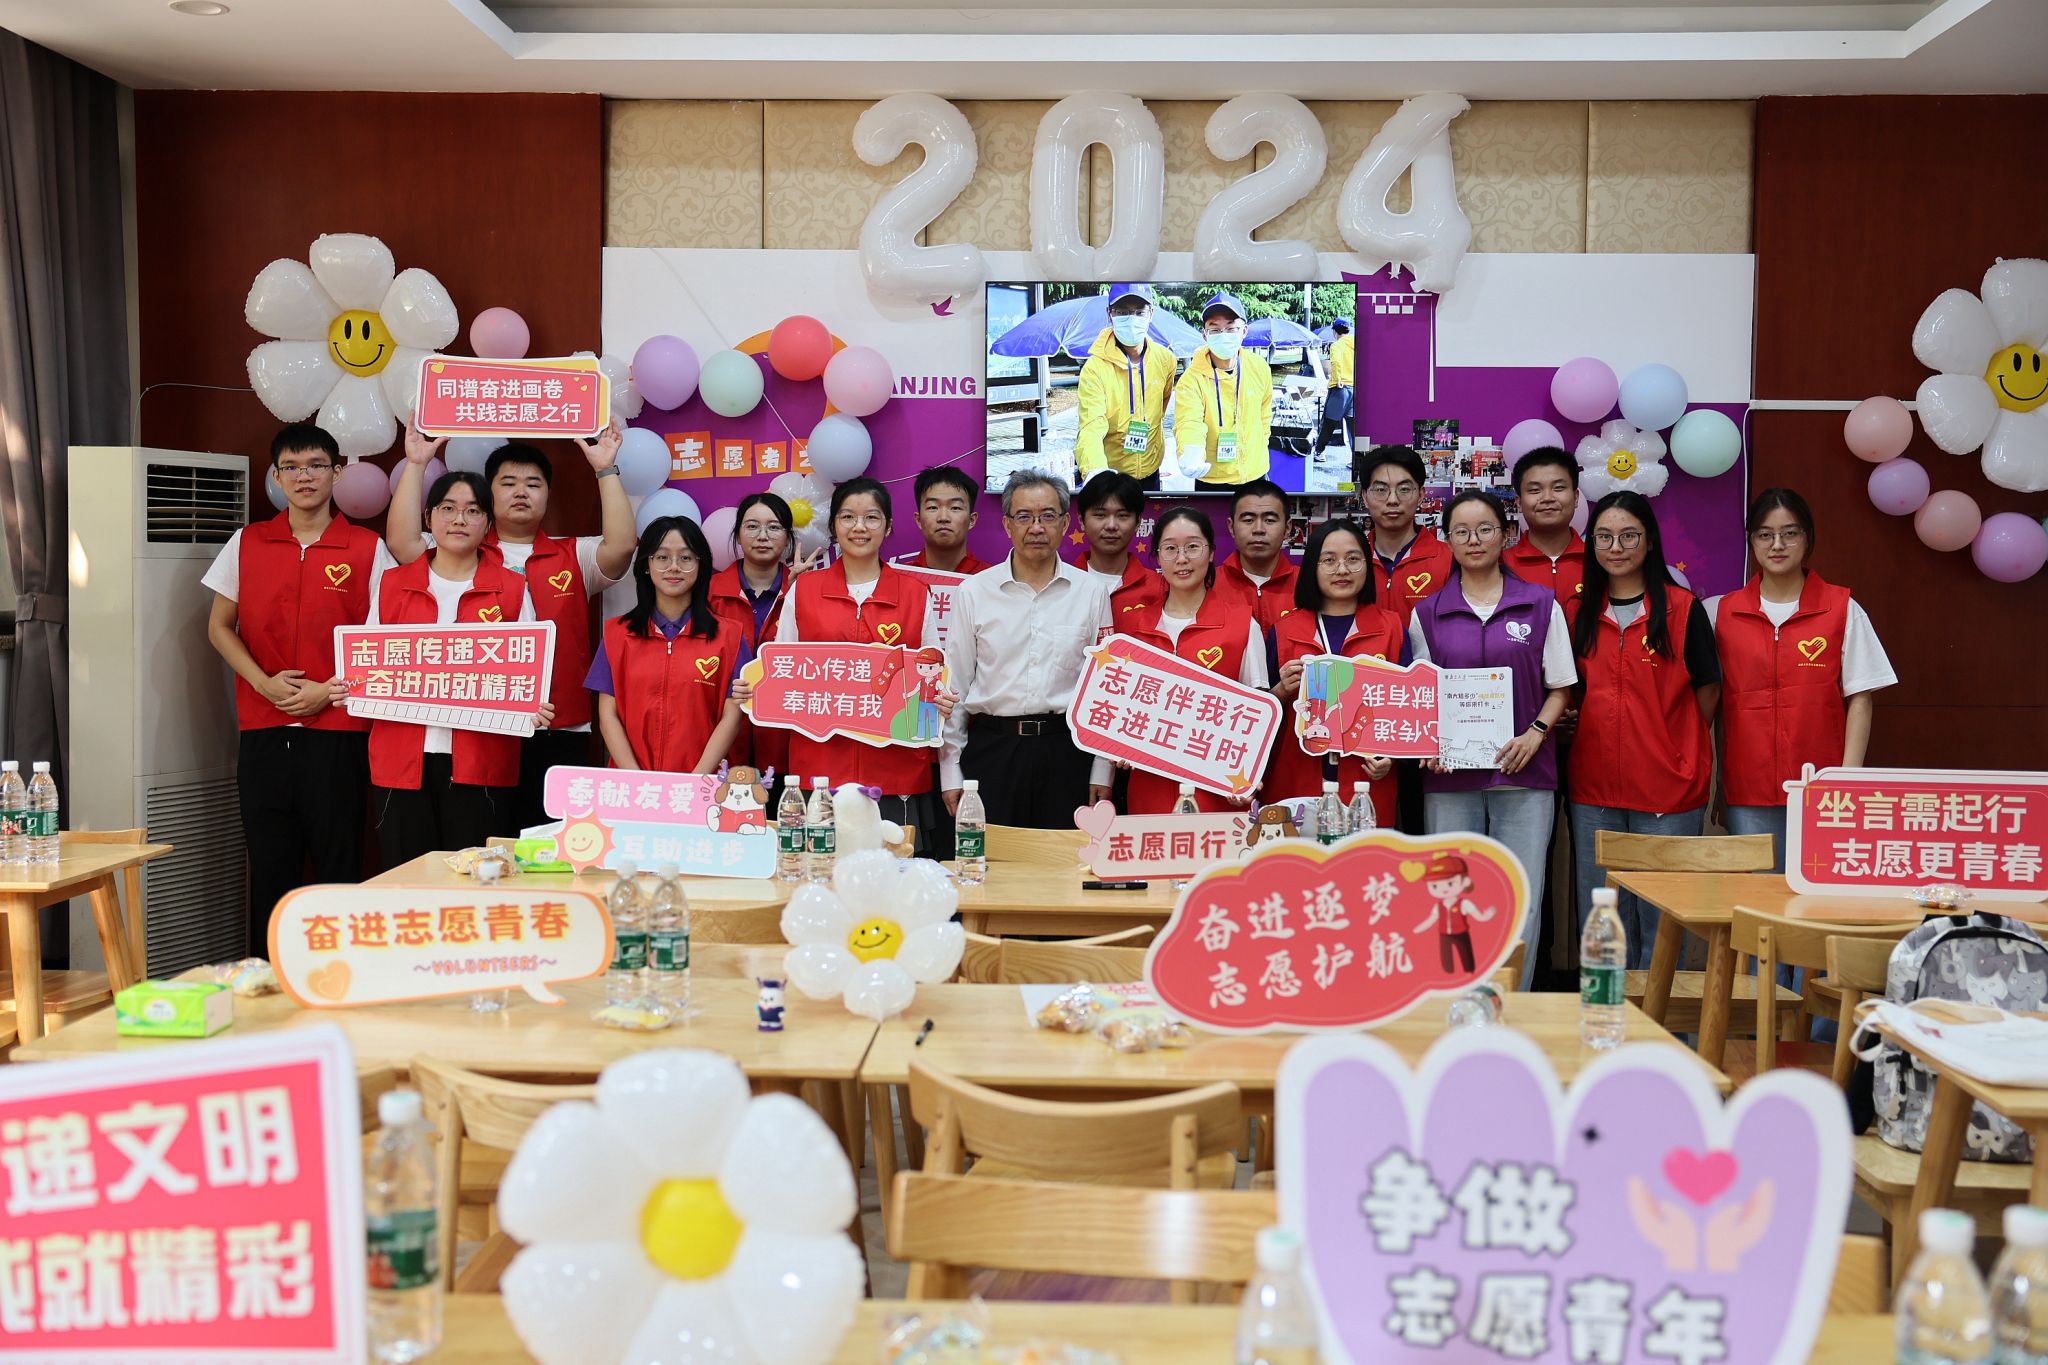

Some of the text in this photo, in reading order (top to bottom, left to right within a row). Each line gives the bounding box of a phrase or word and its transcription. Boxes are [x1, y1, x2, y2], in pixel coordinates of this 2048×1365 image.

[853, 92, 1473, 301] 2024
[436, 378, 563, 399] 同谱奋进画卷
[455, 402, 582, 423] 共践志愿之行
[350, 636, 536, 667] 志愿传递文明
[770, 655, 872, 683] 爱心传递
[364, 669, 536, 702] 奋进成就精彩
[782, 689, 883, 718] 奉献有我
[1098, 665, 1262, 735] 志愿伴我行
[1087, 699, 1248, 769] 奋进正当时
[567, 776, 695, 815] 奉献友爱
[1815, 790, 2028, 834] 坐言需起行
[622, 834, 746, 867] 互助进步
[1106, 830, 1227, 862] 志愿同行
[1831, 838, 2043, 883] 志愿更青春
[302, 901, 571, 951] 奋进志愿青春
[1195, 872, 1400, 953] 奋进逐梦
[1208, 932, 1414, 1009] 志愿护航
[1360, 1145, 1578, 1258] 争做
[1383, 1264, 1729, 1365] 志愿青年
